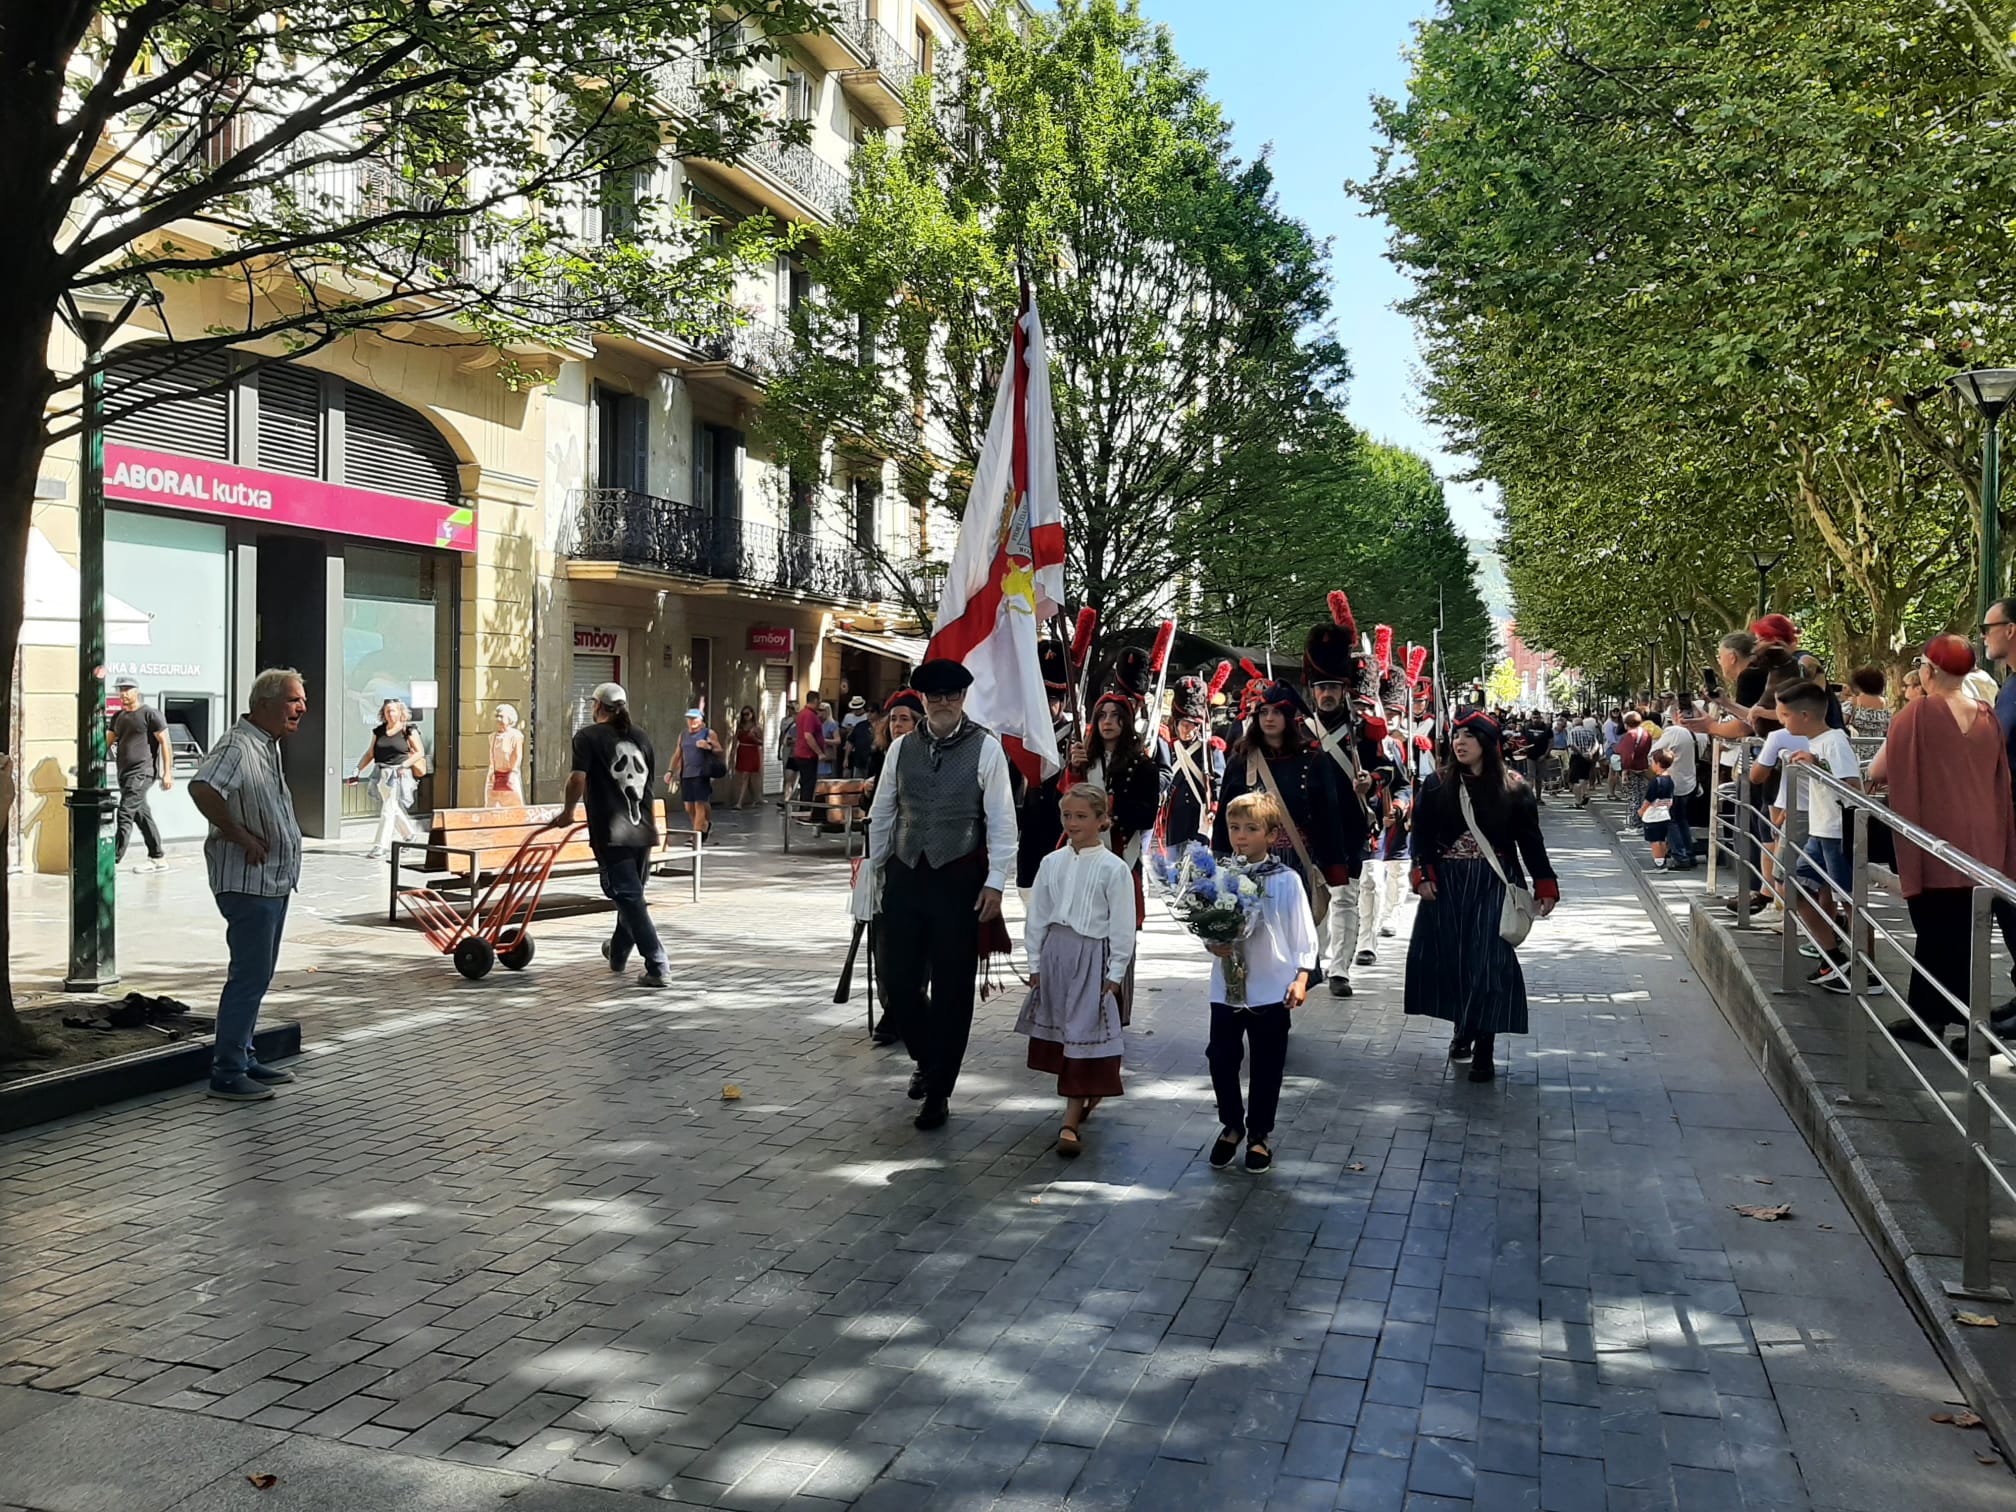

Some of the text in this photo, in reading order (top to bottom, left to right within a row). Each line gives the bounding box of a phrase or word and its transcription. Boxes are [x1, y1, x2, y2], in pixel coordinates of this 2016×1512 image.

[213, 478, 272, 510] kutxa
[106, 662, 201, 676] NKA & ASEGURUAK
